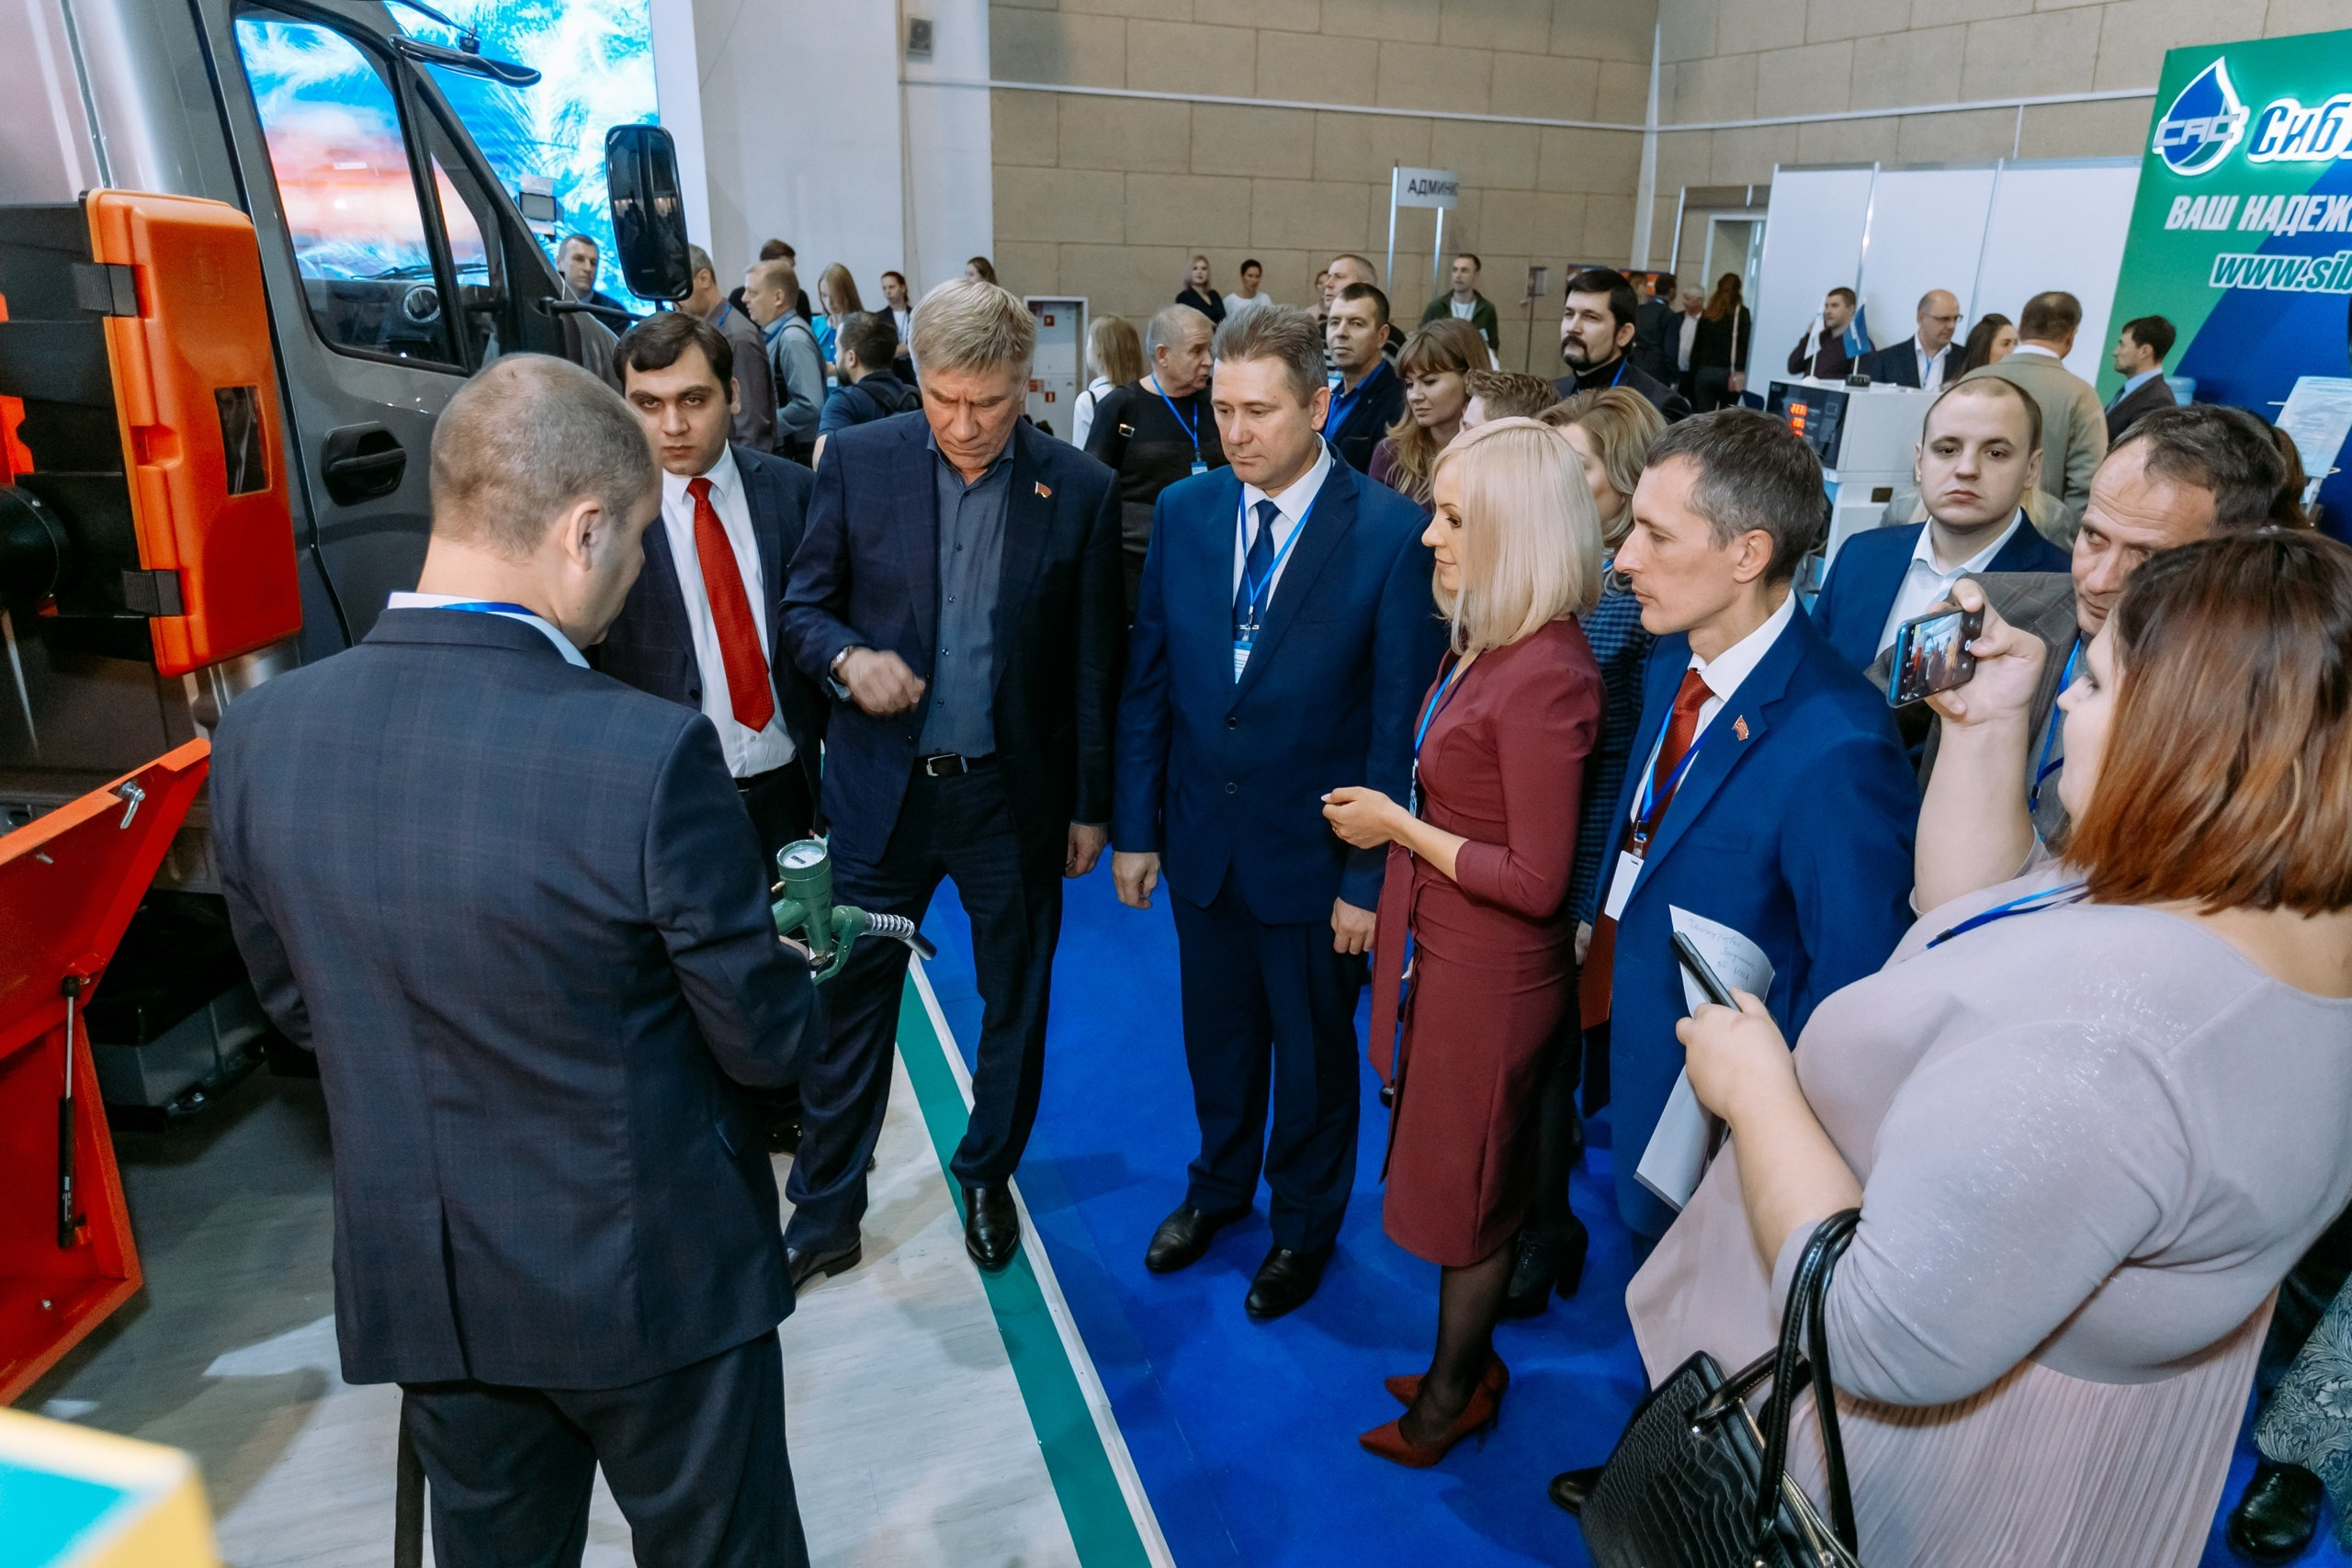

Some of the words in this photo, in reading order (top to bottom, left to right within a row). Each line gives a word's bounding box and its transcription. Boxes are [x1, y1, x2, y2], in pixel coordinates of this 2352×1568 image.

[2248, 97, 2352, 158] Сиб
[2164, 195, 2240, 231] ВАШ
[2236, 195, 2352, 237] НАДЕЖ
